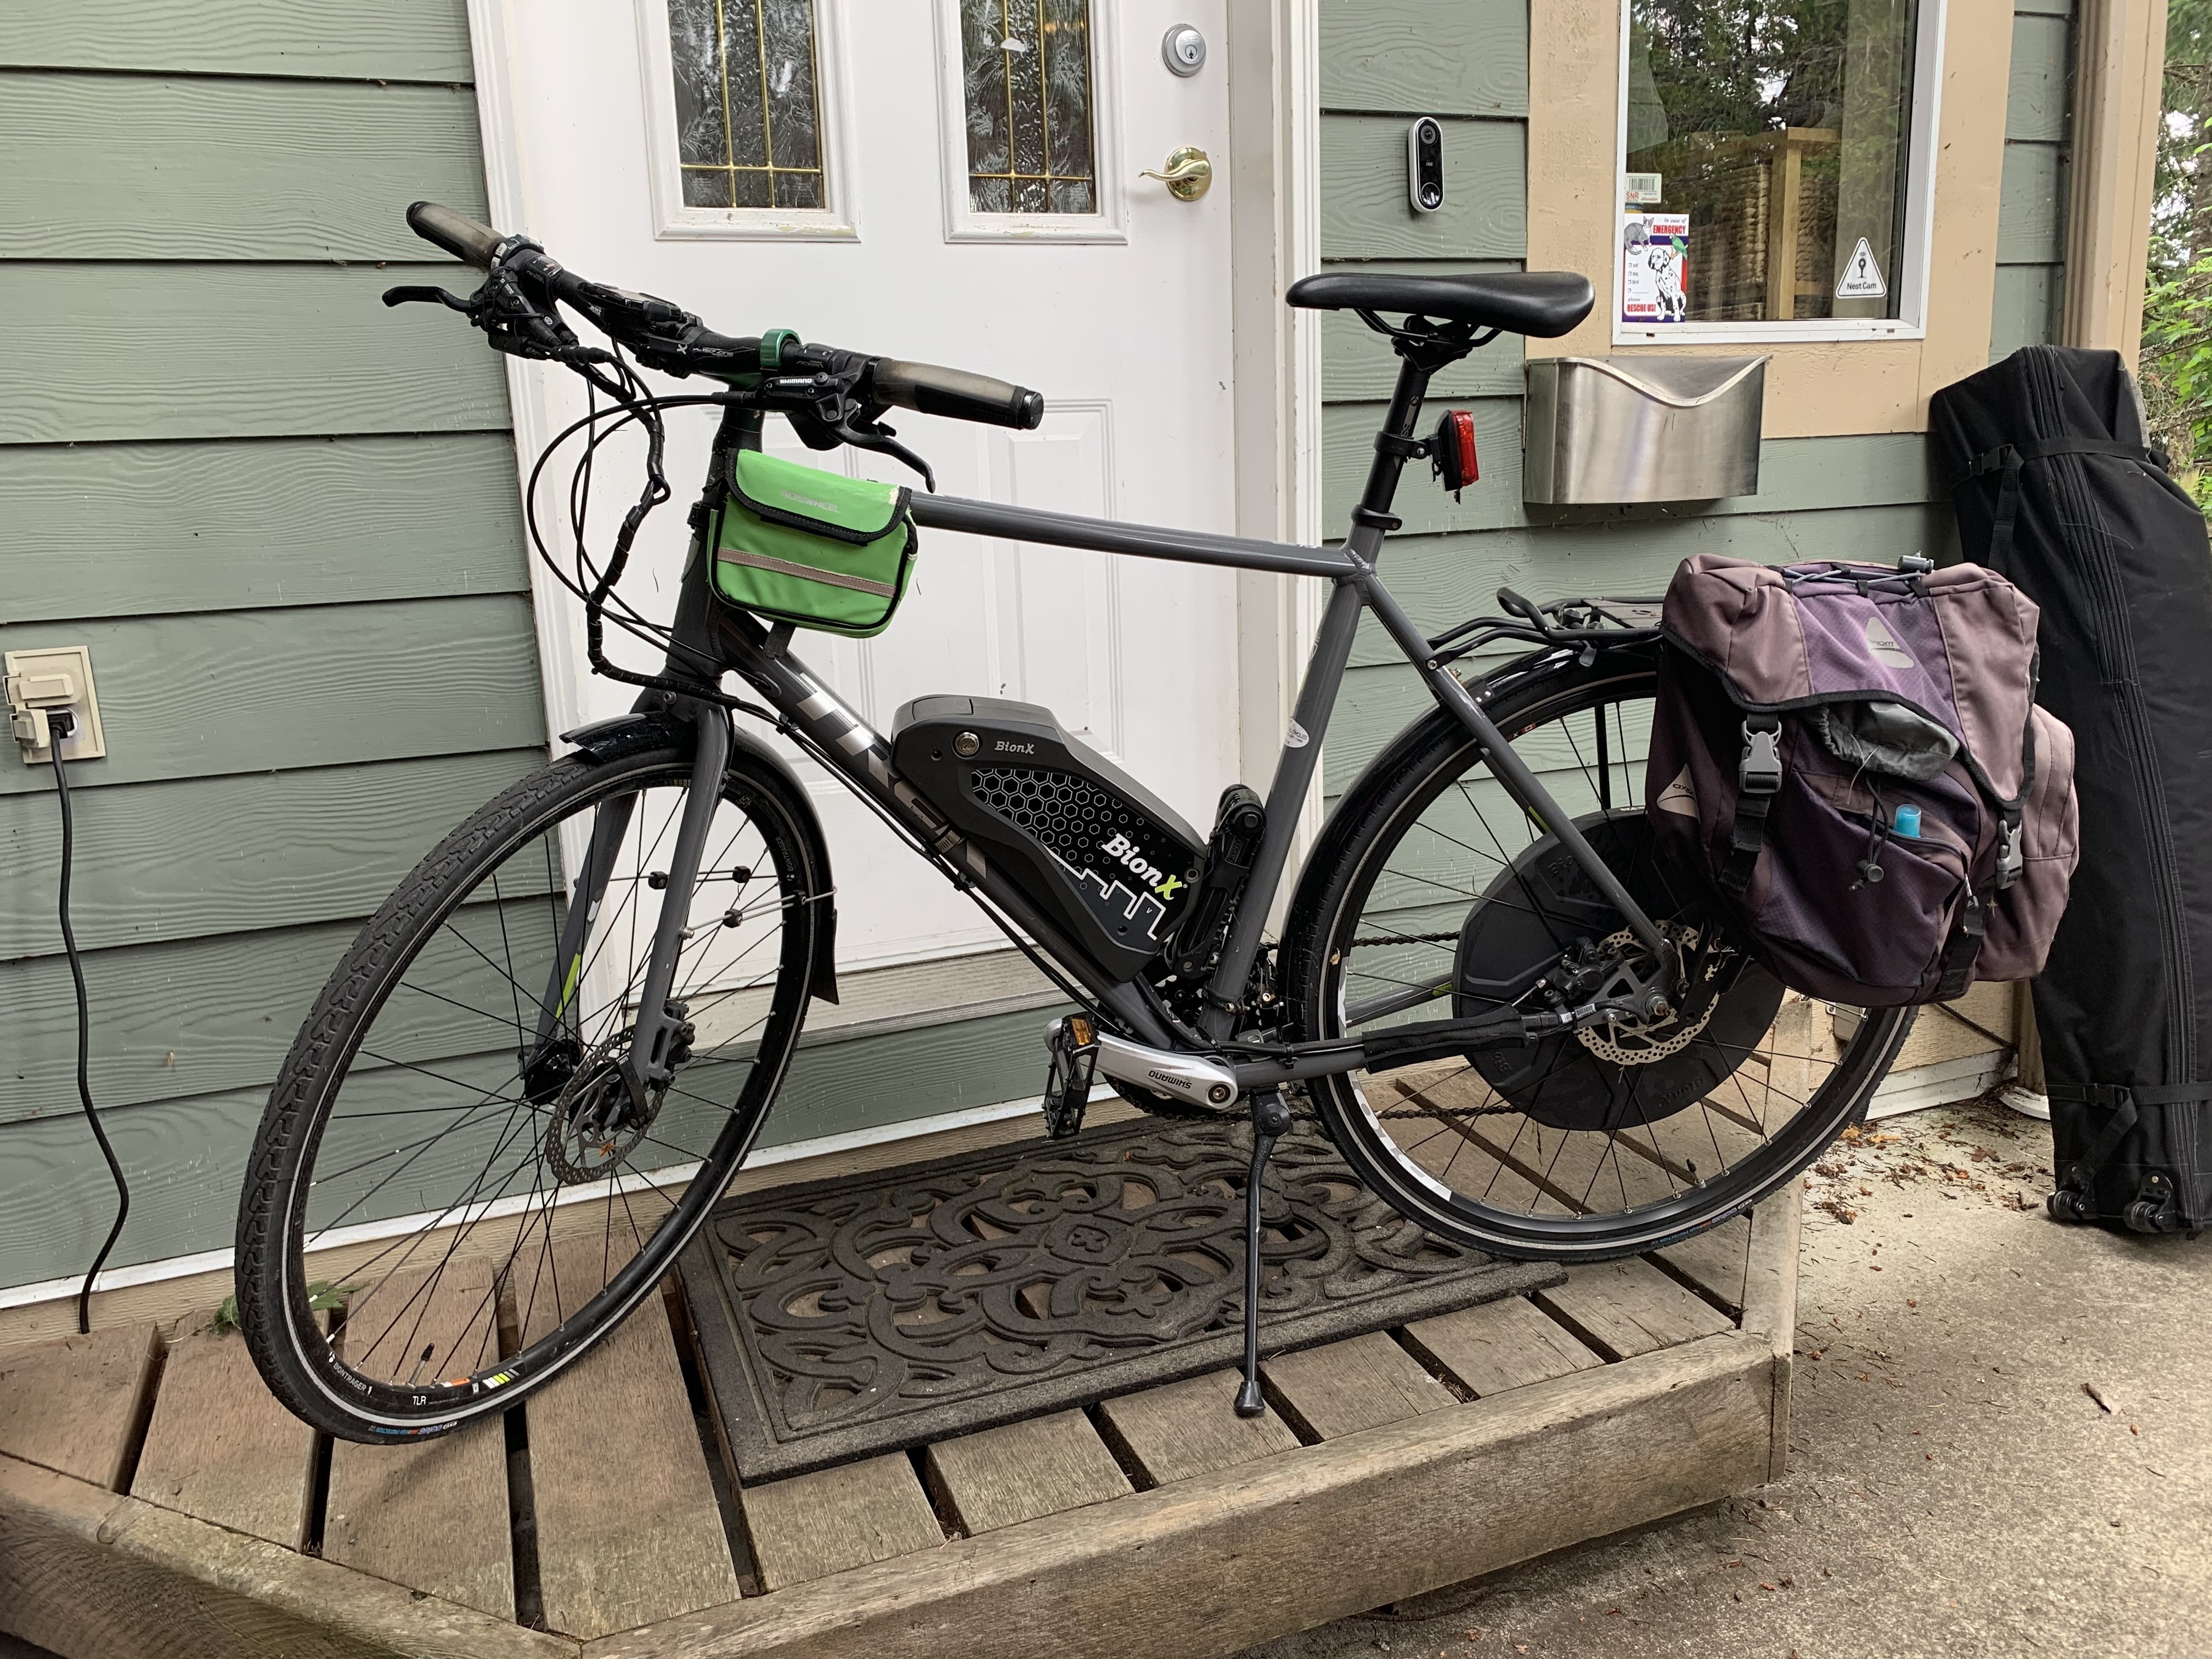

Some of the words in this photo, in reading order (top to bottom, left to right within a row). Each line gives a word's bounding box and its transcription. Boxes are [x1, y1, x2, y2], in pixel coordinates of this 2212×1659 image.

[1653, 225, 1686, 234] EMERGENCY
[1627, 304, 1646, 312] RESCUE
[1647, 304, 1656, 312] US!
[994, 740, 1035, 755] BionX
[775, 836, 794, 872] BONTRAGER
[1101, 832, 1183, 900] BionX
[1148, 1070, 1193, 1089] SHIMANO
[333, 1362, 367, 1392] BONTRAGER
[413, 1396, 426, 1405] TLR
